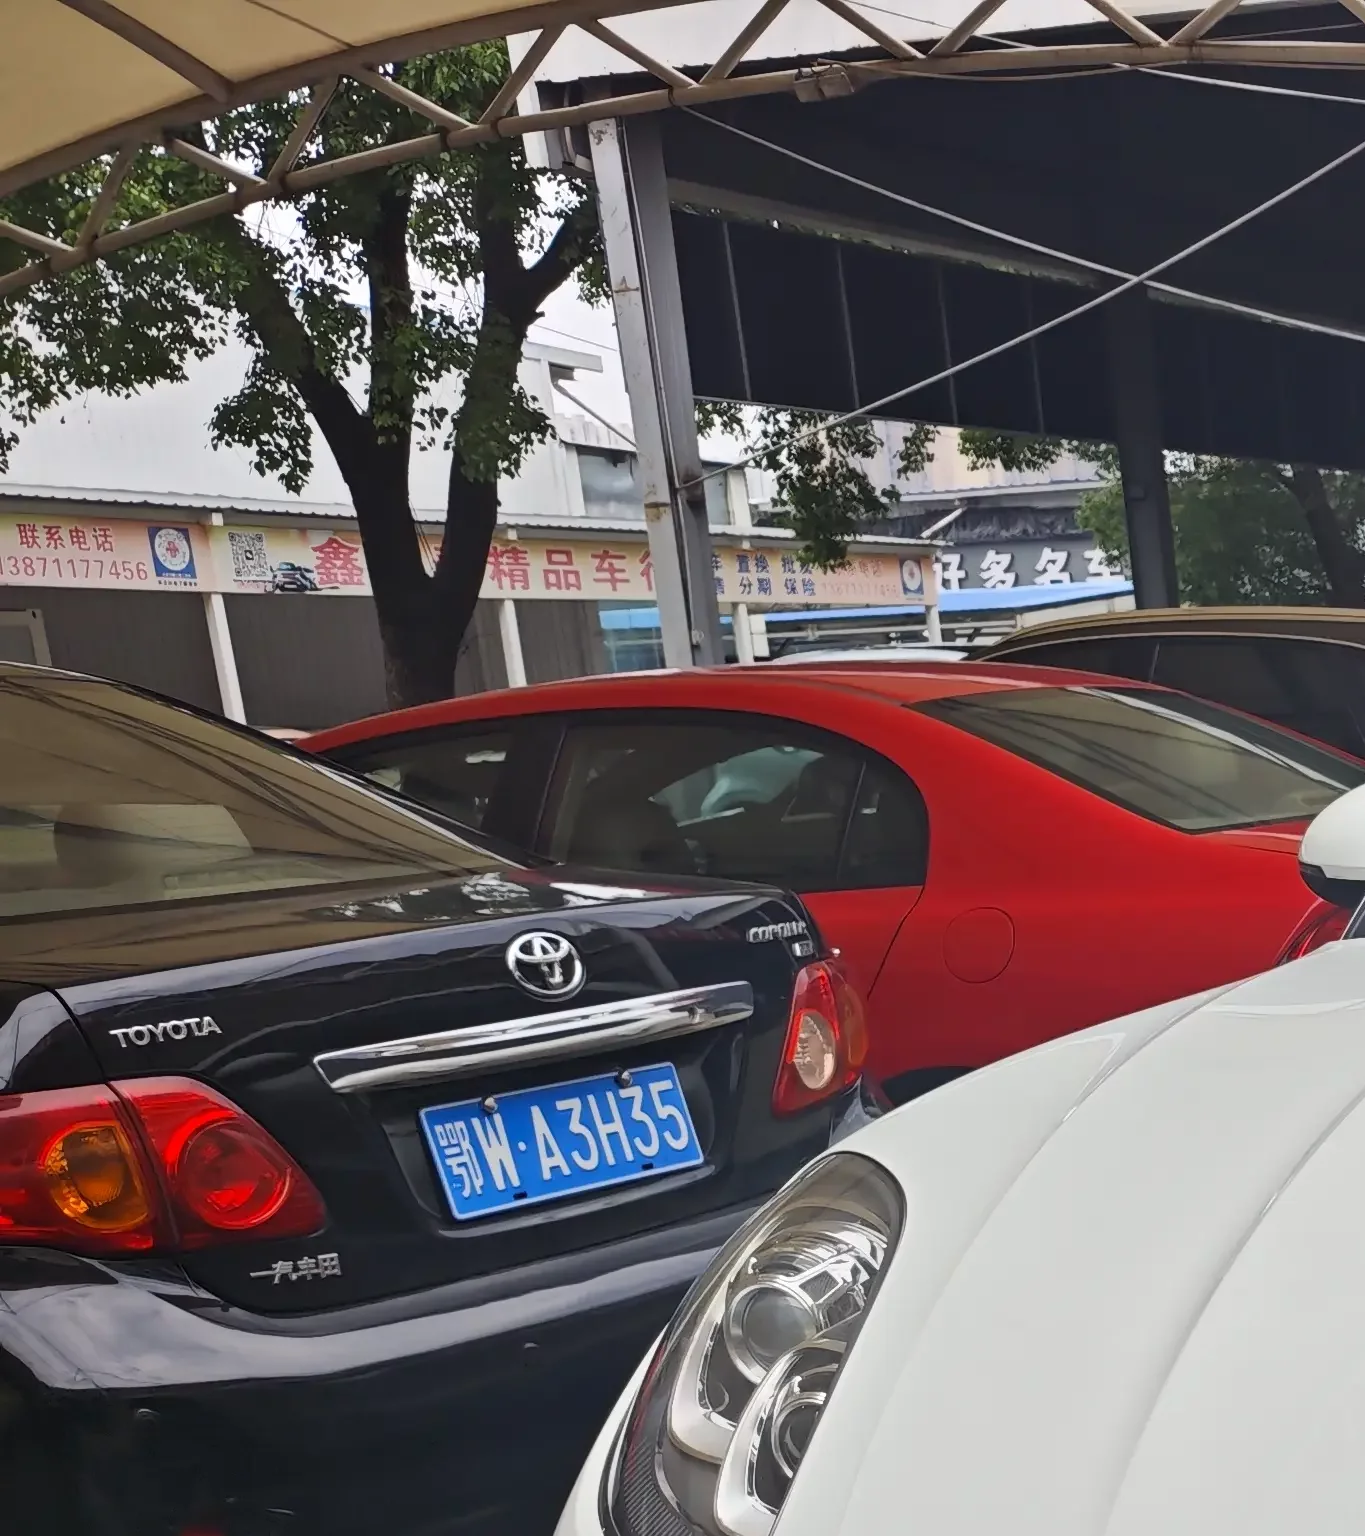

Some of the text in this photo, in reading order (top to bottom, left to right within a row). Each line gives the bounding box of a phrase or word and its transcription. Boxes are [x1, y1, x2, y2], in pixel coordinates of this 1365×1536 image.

[16, 523, 114, 552] 联系电话
[0, 555, 148, 581] 13871177456
[109, 1016, 222, 1047] TOYOTA
[434, 1079, 690, 1198] 鄂W·A3H35
